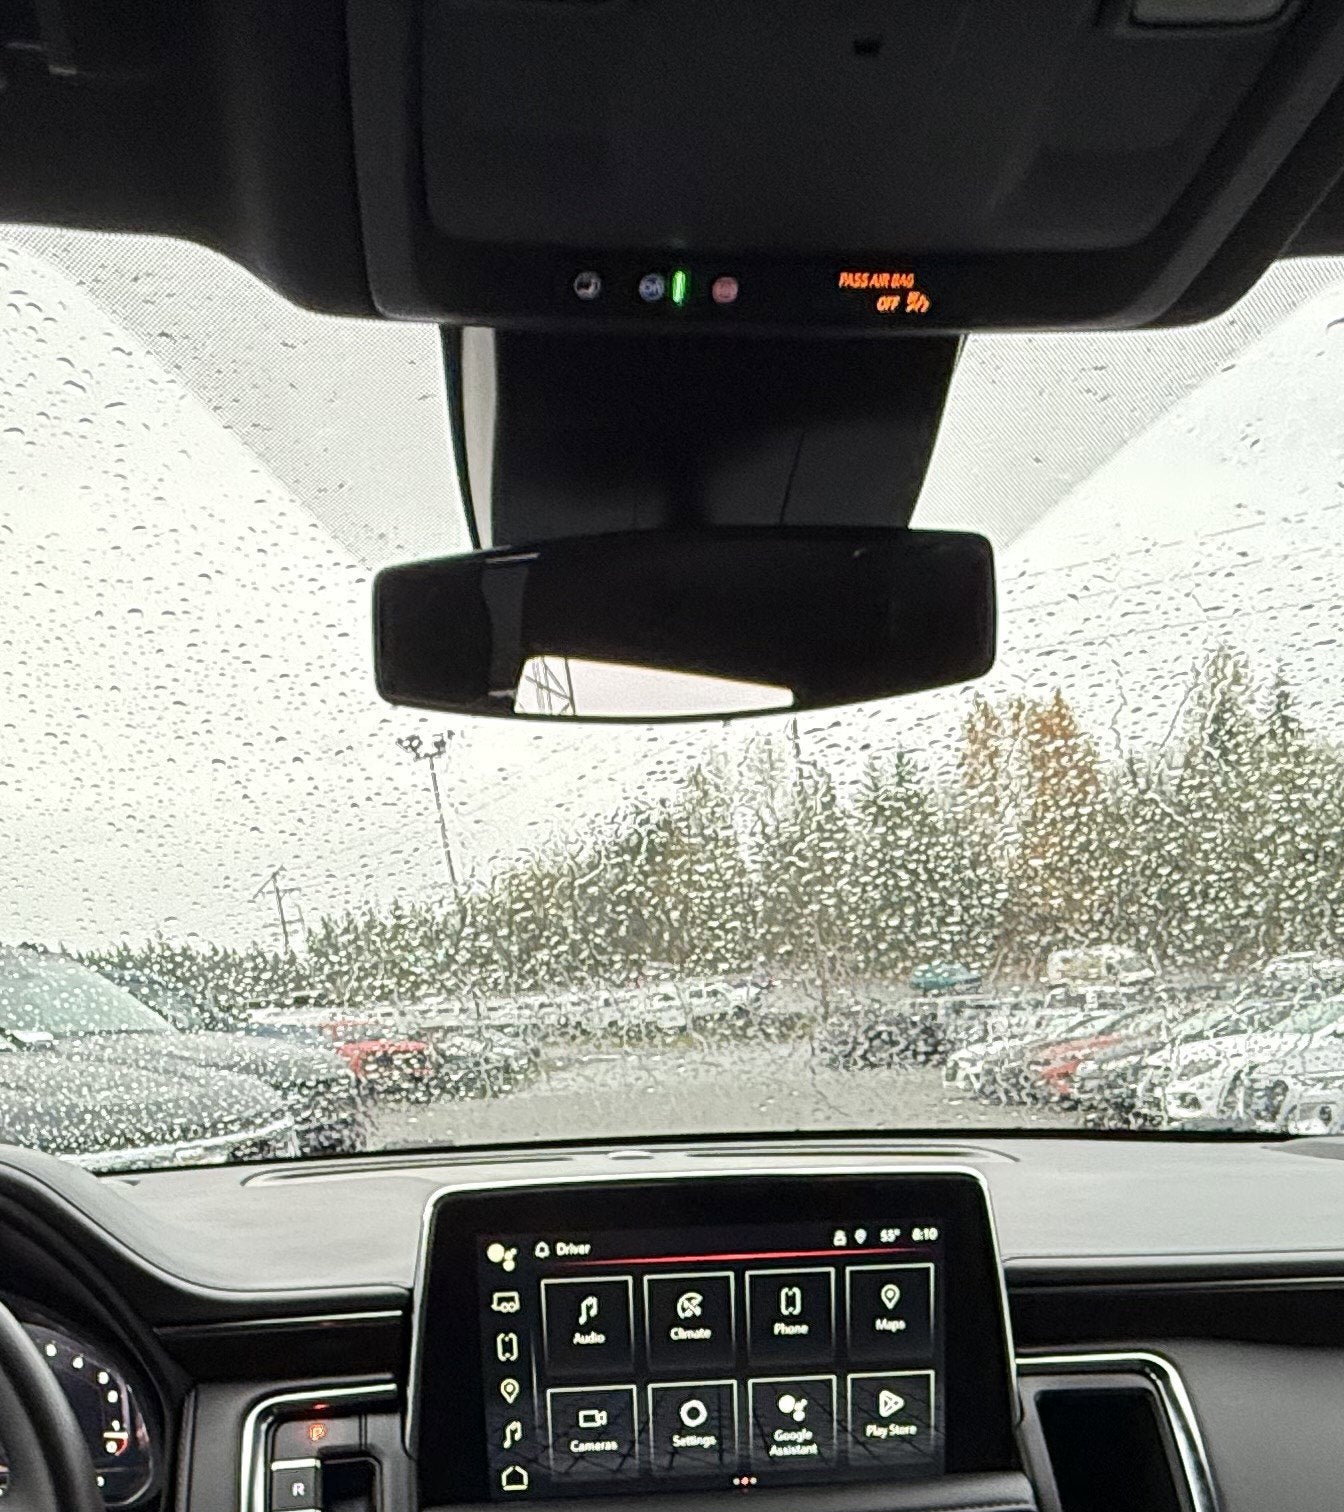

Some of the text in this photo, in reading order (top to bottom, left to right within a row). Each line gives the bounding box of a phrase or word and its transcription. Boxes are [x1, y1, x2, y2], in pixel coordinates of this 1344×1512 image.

[839, 272, 914, 289] PASS AIR BAG
[876, 296, 900, 312] OFF
[912, 1227, 938, 1241] 8:10
[556, 1241, 590, 1255] Driver
[773, 1322, 809, 1335] Phone
[875, 1318, 906, 1333] Maps
[573, 1331, 605, 1345] Audio
[670, 1327, 712, 1341] Climate
[310, 1424, 325, 1441] P
[774, 1428, 813, 1444] Google
[866, 1423, 917, 1440] Play Store
[570, 1438, 618, 1453] Cameras
[672, 1434, 717, 1449] Settings
[769, 1442, 818, 1457] Assistant
[292, 1482, 305, 1497] R
